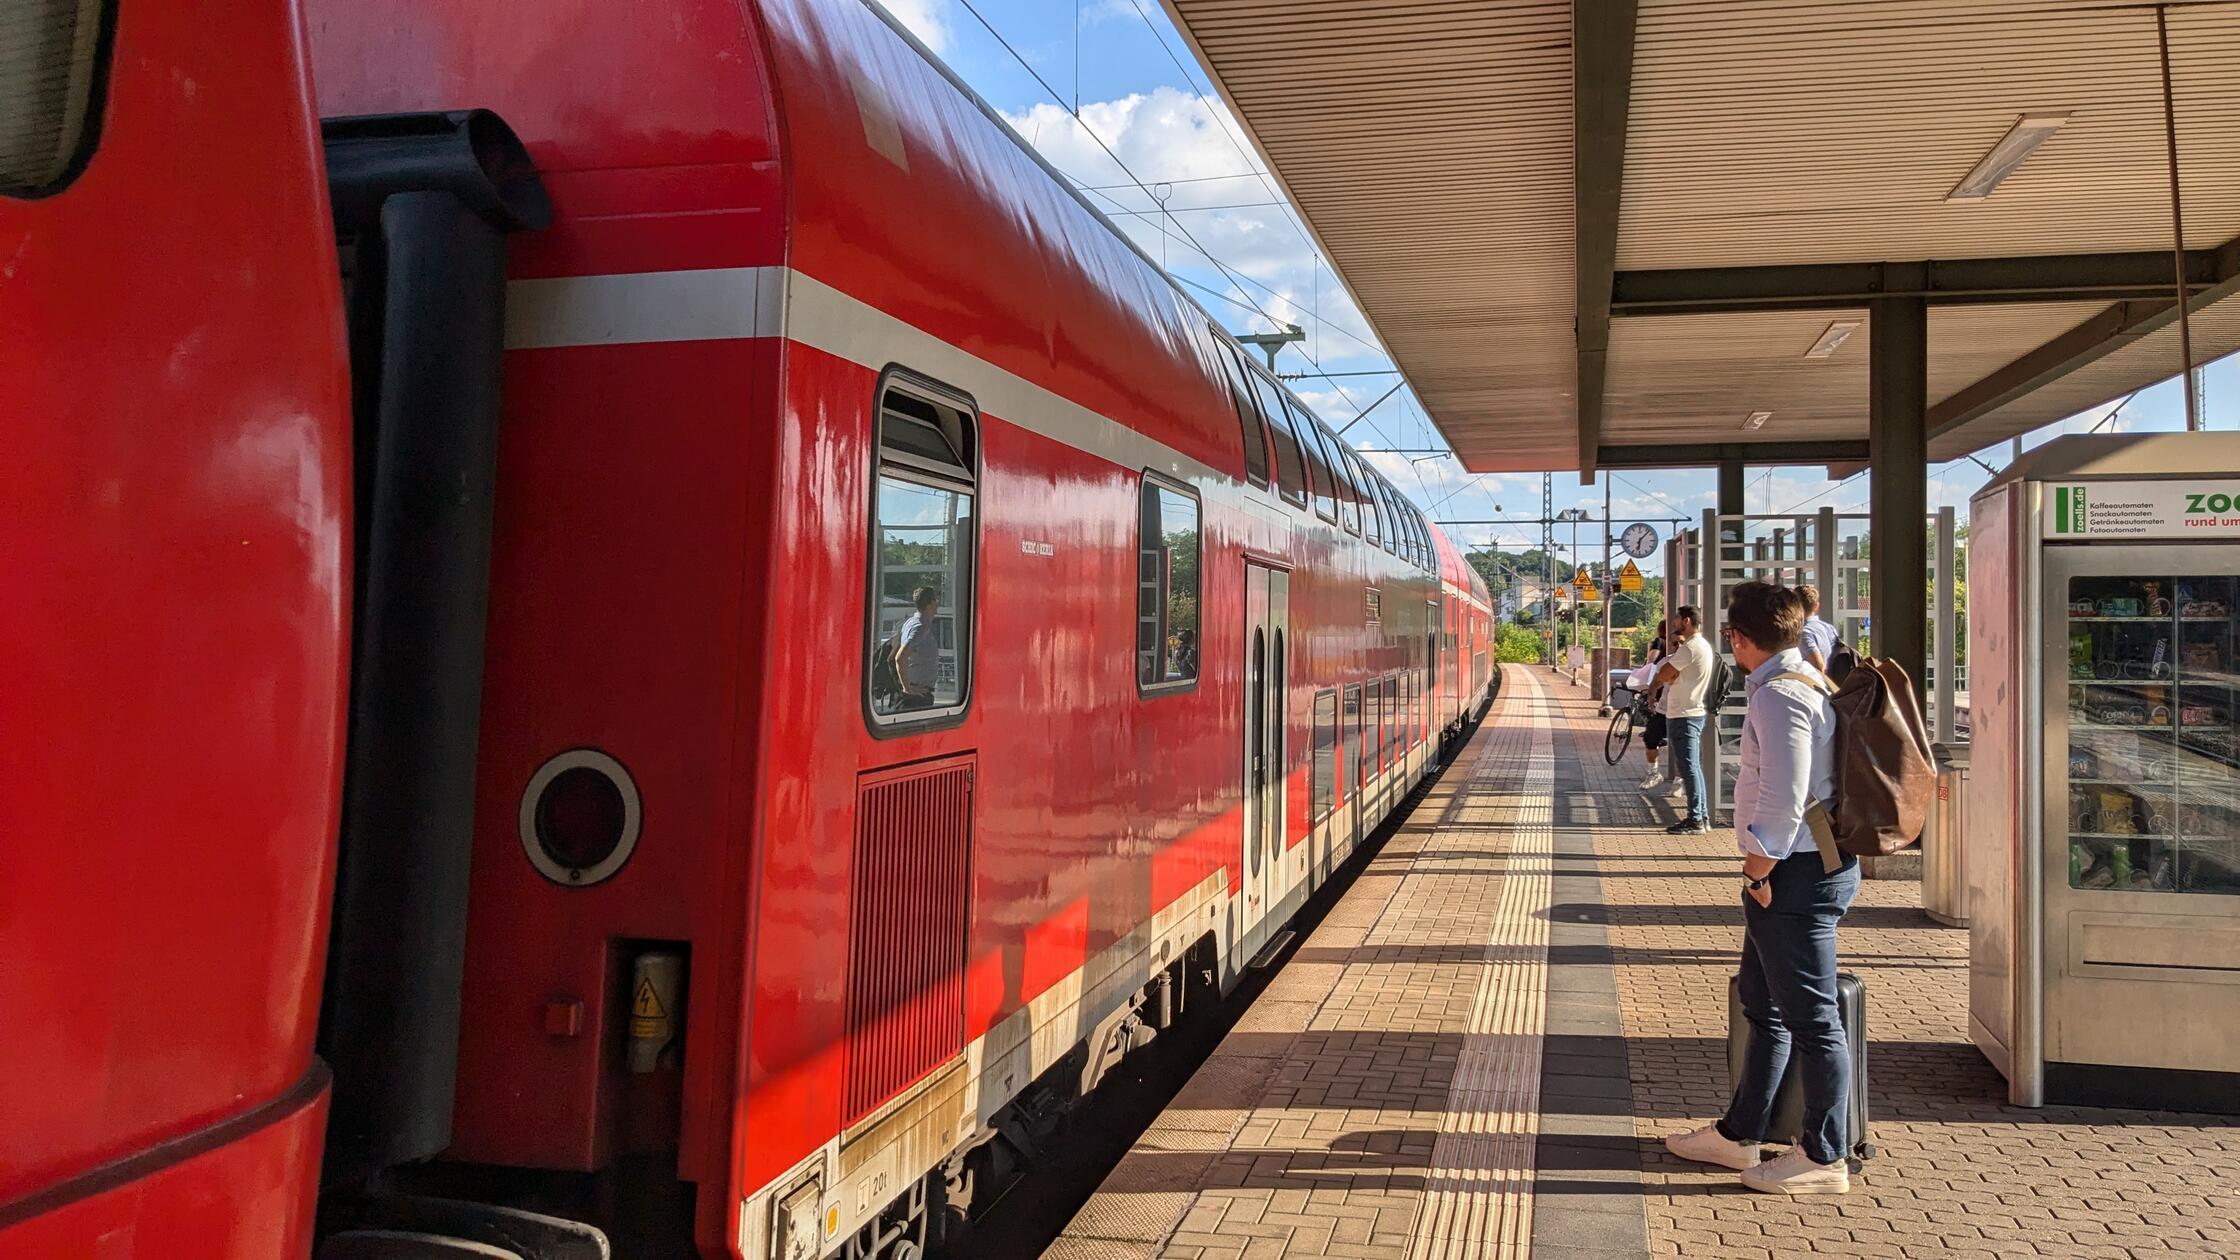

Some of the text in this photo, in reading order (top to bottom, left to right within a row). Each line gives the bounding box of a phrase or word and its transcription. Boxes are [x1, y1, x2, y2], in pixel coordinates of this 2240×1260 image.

[2075, 488, 2085, 532] zoells.de
[2089, 502, 2154, 510] Kaffeeautomaten
[2089, 510, 2153, 518] Snackautomaten
[2089, 518, 2165, 526] Getränkeautomaten
[2184, 516, 2217, 527] rund
[2089, 526, 2147, 534] Fotoautomaten
